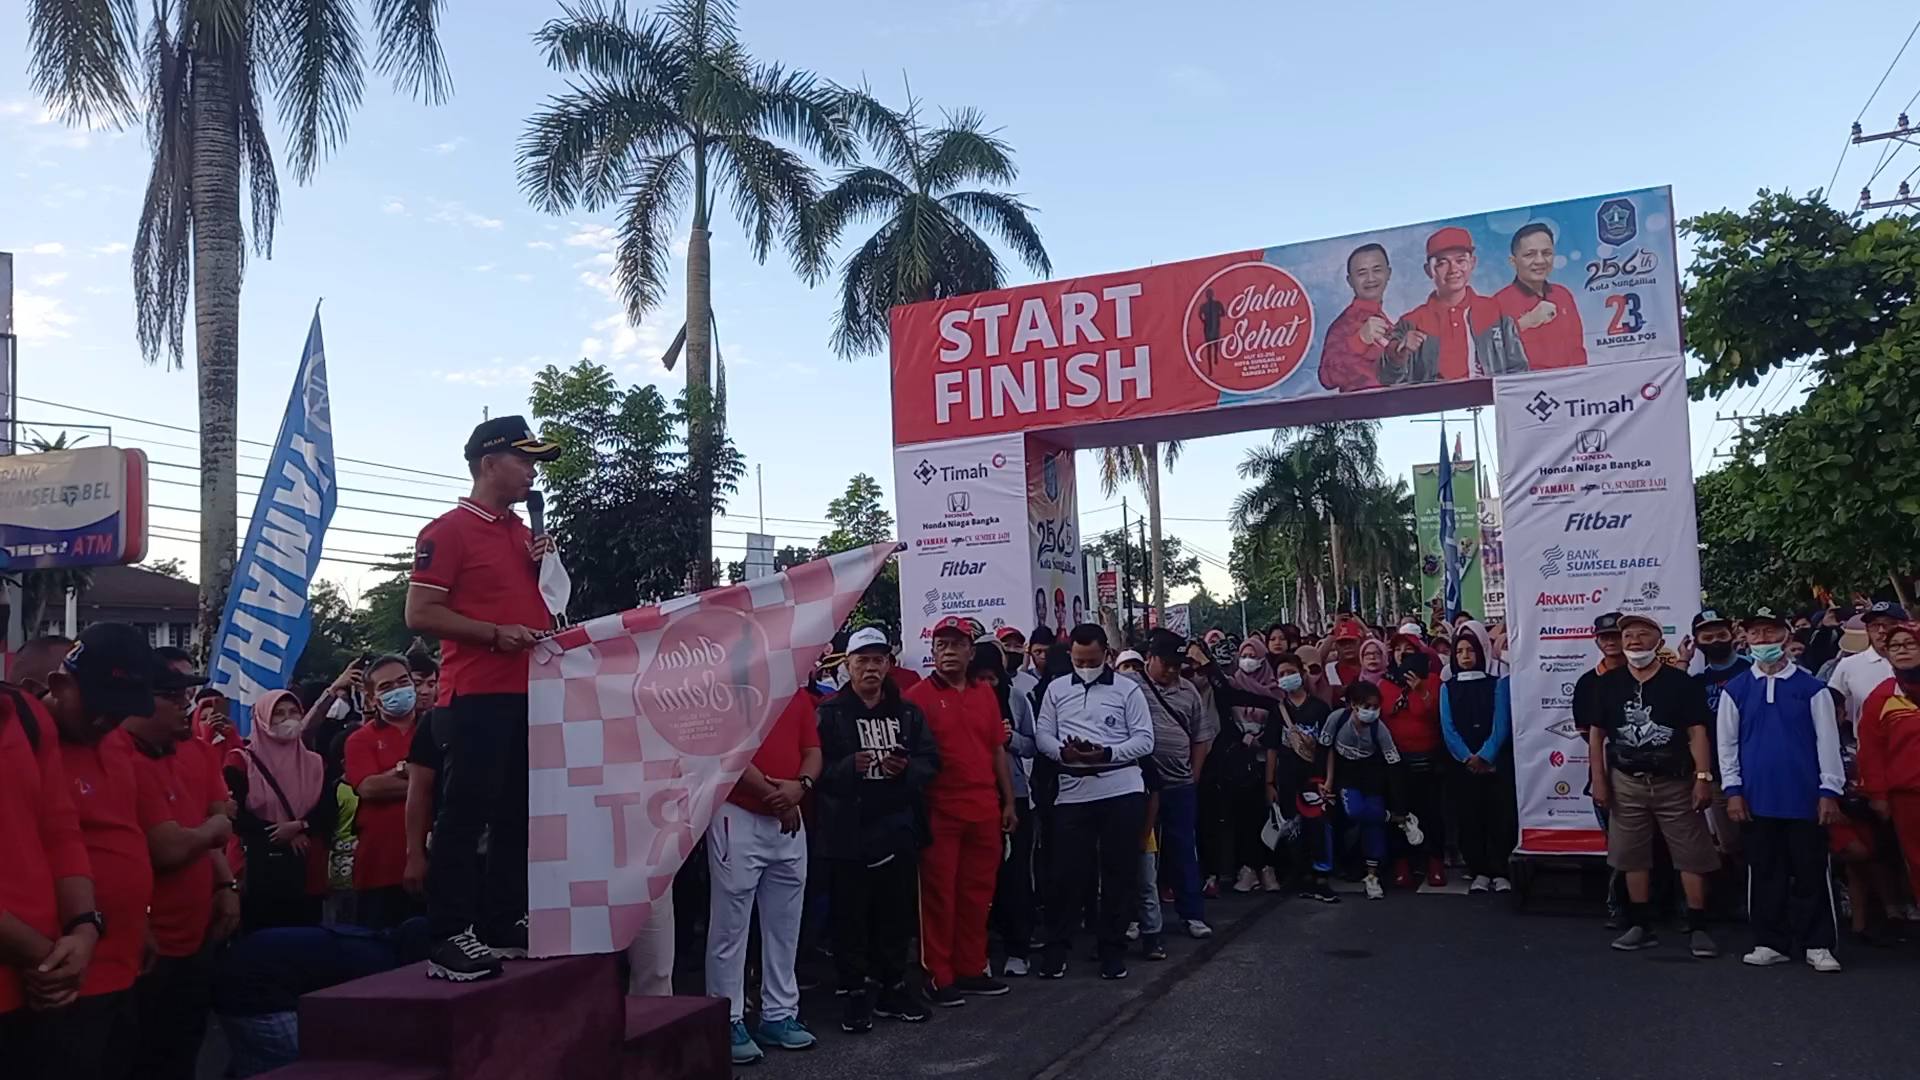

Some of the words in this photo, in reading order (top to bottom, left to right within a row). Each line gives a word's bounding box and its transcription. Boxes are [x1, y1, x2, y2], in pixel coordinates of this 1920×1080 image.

[1589, 282, 1609, 292] Kota
[1612, 278, 1657, 288] Sungailiat
[1227, 283, 1301, 319] Jalan
[938, 282, 1143, 364] START
[1605, 293, 1646, 336] 23
[1195, 315, 1307, 362] Sehat
[1596, 336, 1636, 346] BANGKA
[1638, 332, 1657, 342] POS
[933, 345, 1152, 424] FINISH
[1564, 395, 1634, 418] Timah
[1571, 453, 1613, 462] HONDA
[940, 463, 988, 482] Timah
[1539, 465, 1573, 476] Honda
[1576, 462, 1607, 475] Niaga
[1610, 458, 1651, 471] Bangka
[1538, 483, 1576, 495] YAMAHA
[922, 521, 946, 530] Honda
[948, 519, 970, 529] Niaga
[971, 516, 1000, 526] Bangka
[1564, 511, 1632, 533] Fitbar
[71, 534, 113, 556] ATM
[923, 536, 948, 545] YAMAHA
[1567, 549, 1599, 560] BANK
[211, 433, 331, 706] YAMAHA
[940, 560, 986, 577] Fitbar
[1566, 559, 1617, 571] SUMSEL
[1620, 557, 1661, 569] BABEL
[941, 591, 964, 600] BANK
[941, 600, 976, 610] SUMSEL
[978, 598, 1006, 608] BABEL
[1535, 589, 1602, 606] ARKAVIT-C
